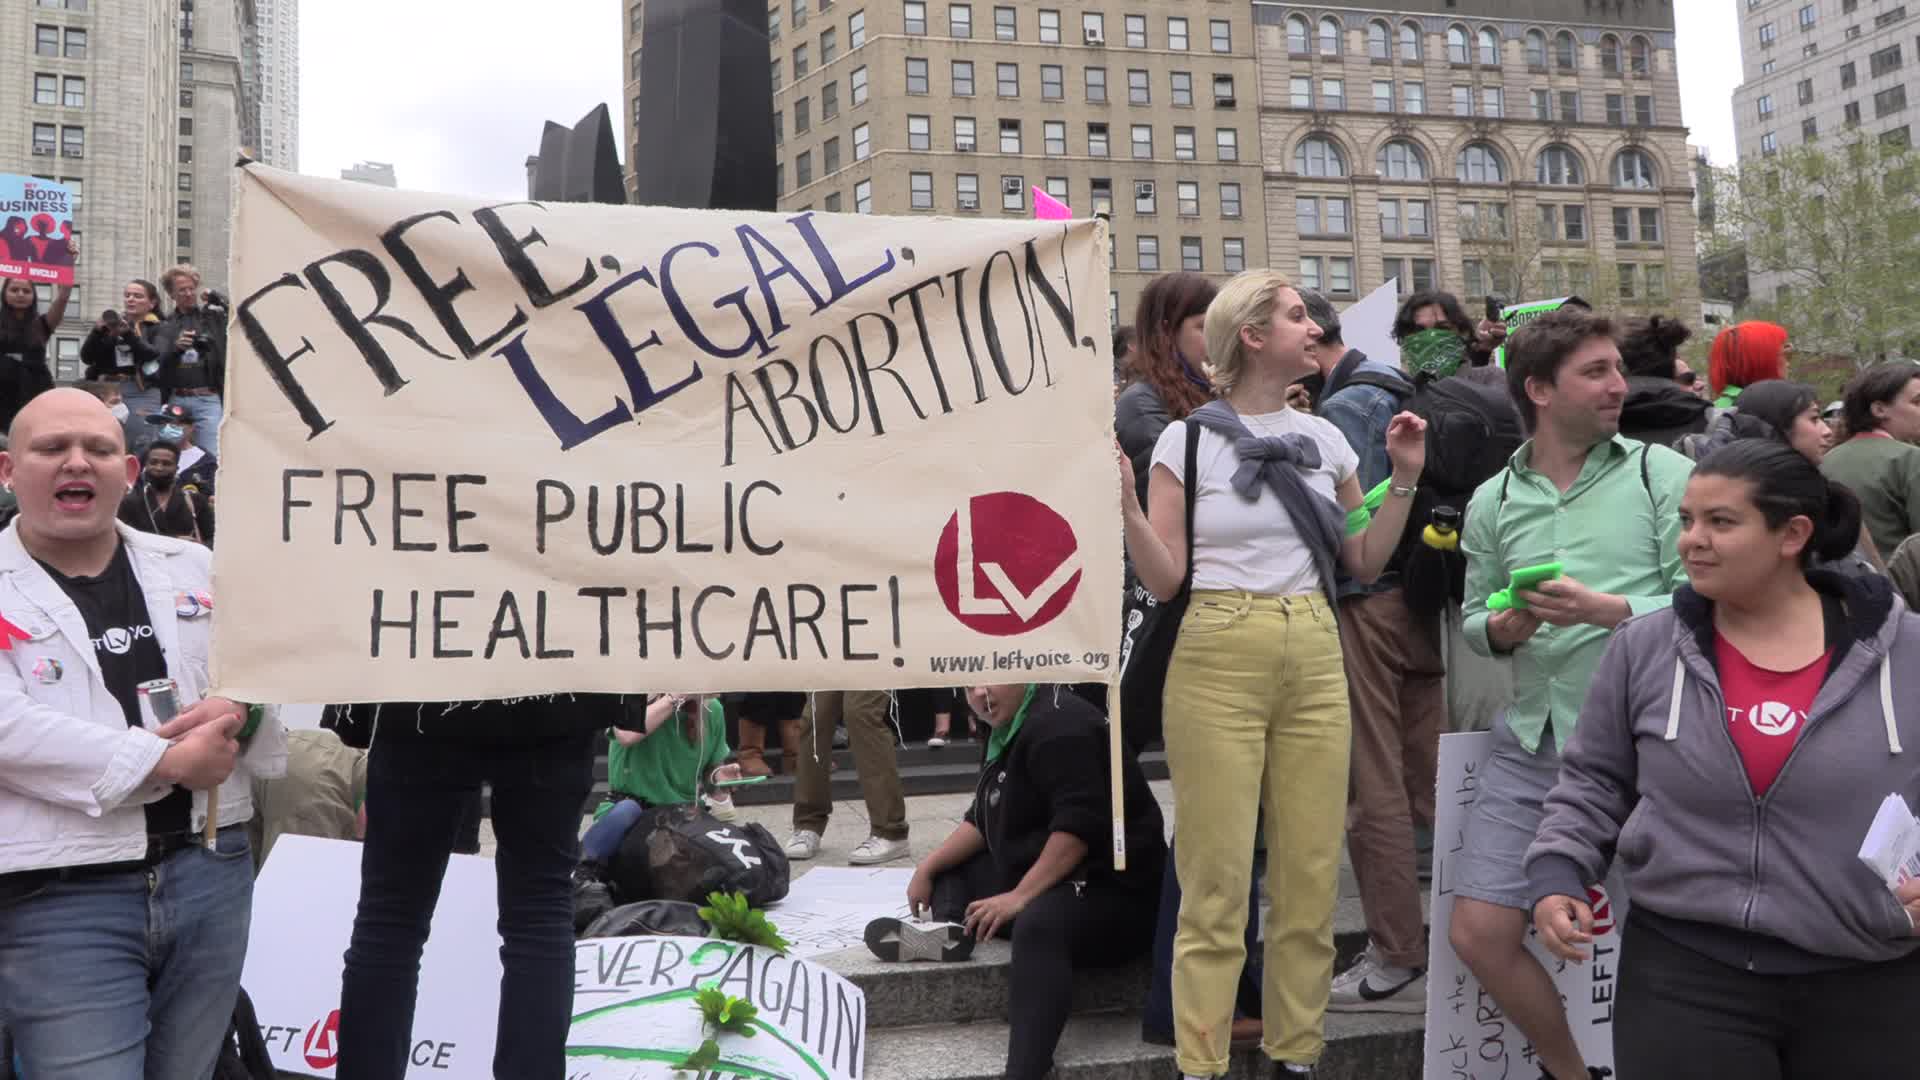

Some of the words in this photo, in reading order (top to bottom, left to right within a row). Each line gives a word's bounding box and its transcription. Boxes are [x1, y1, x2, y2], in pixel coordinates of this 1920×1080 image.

[0, 200, 68, 213] USINESS
[24, 189, 66, 201] BODY
[237, 201, 621, 440] FREE,
[491, 211, 915, 452] LEGAL,
[721, 224, 1096, 467] ABORTION,
[281, 468, 490, 546] FREE
[536, 479, 784, 556] PUBLIC
[370, 575, 905, 668] HEALTHCARE!
[1455, 760, 1476, 809] the
[719, 947, 863, 1079] AGAIN
[1446, 975, 1466, 1014] the
[1592, 944, 1614, 1025] LEFT
